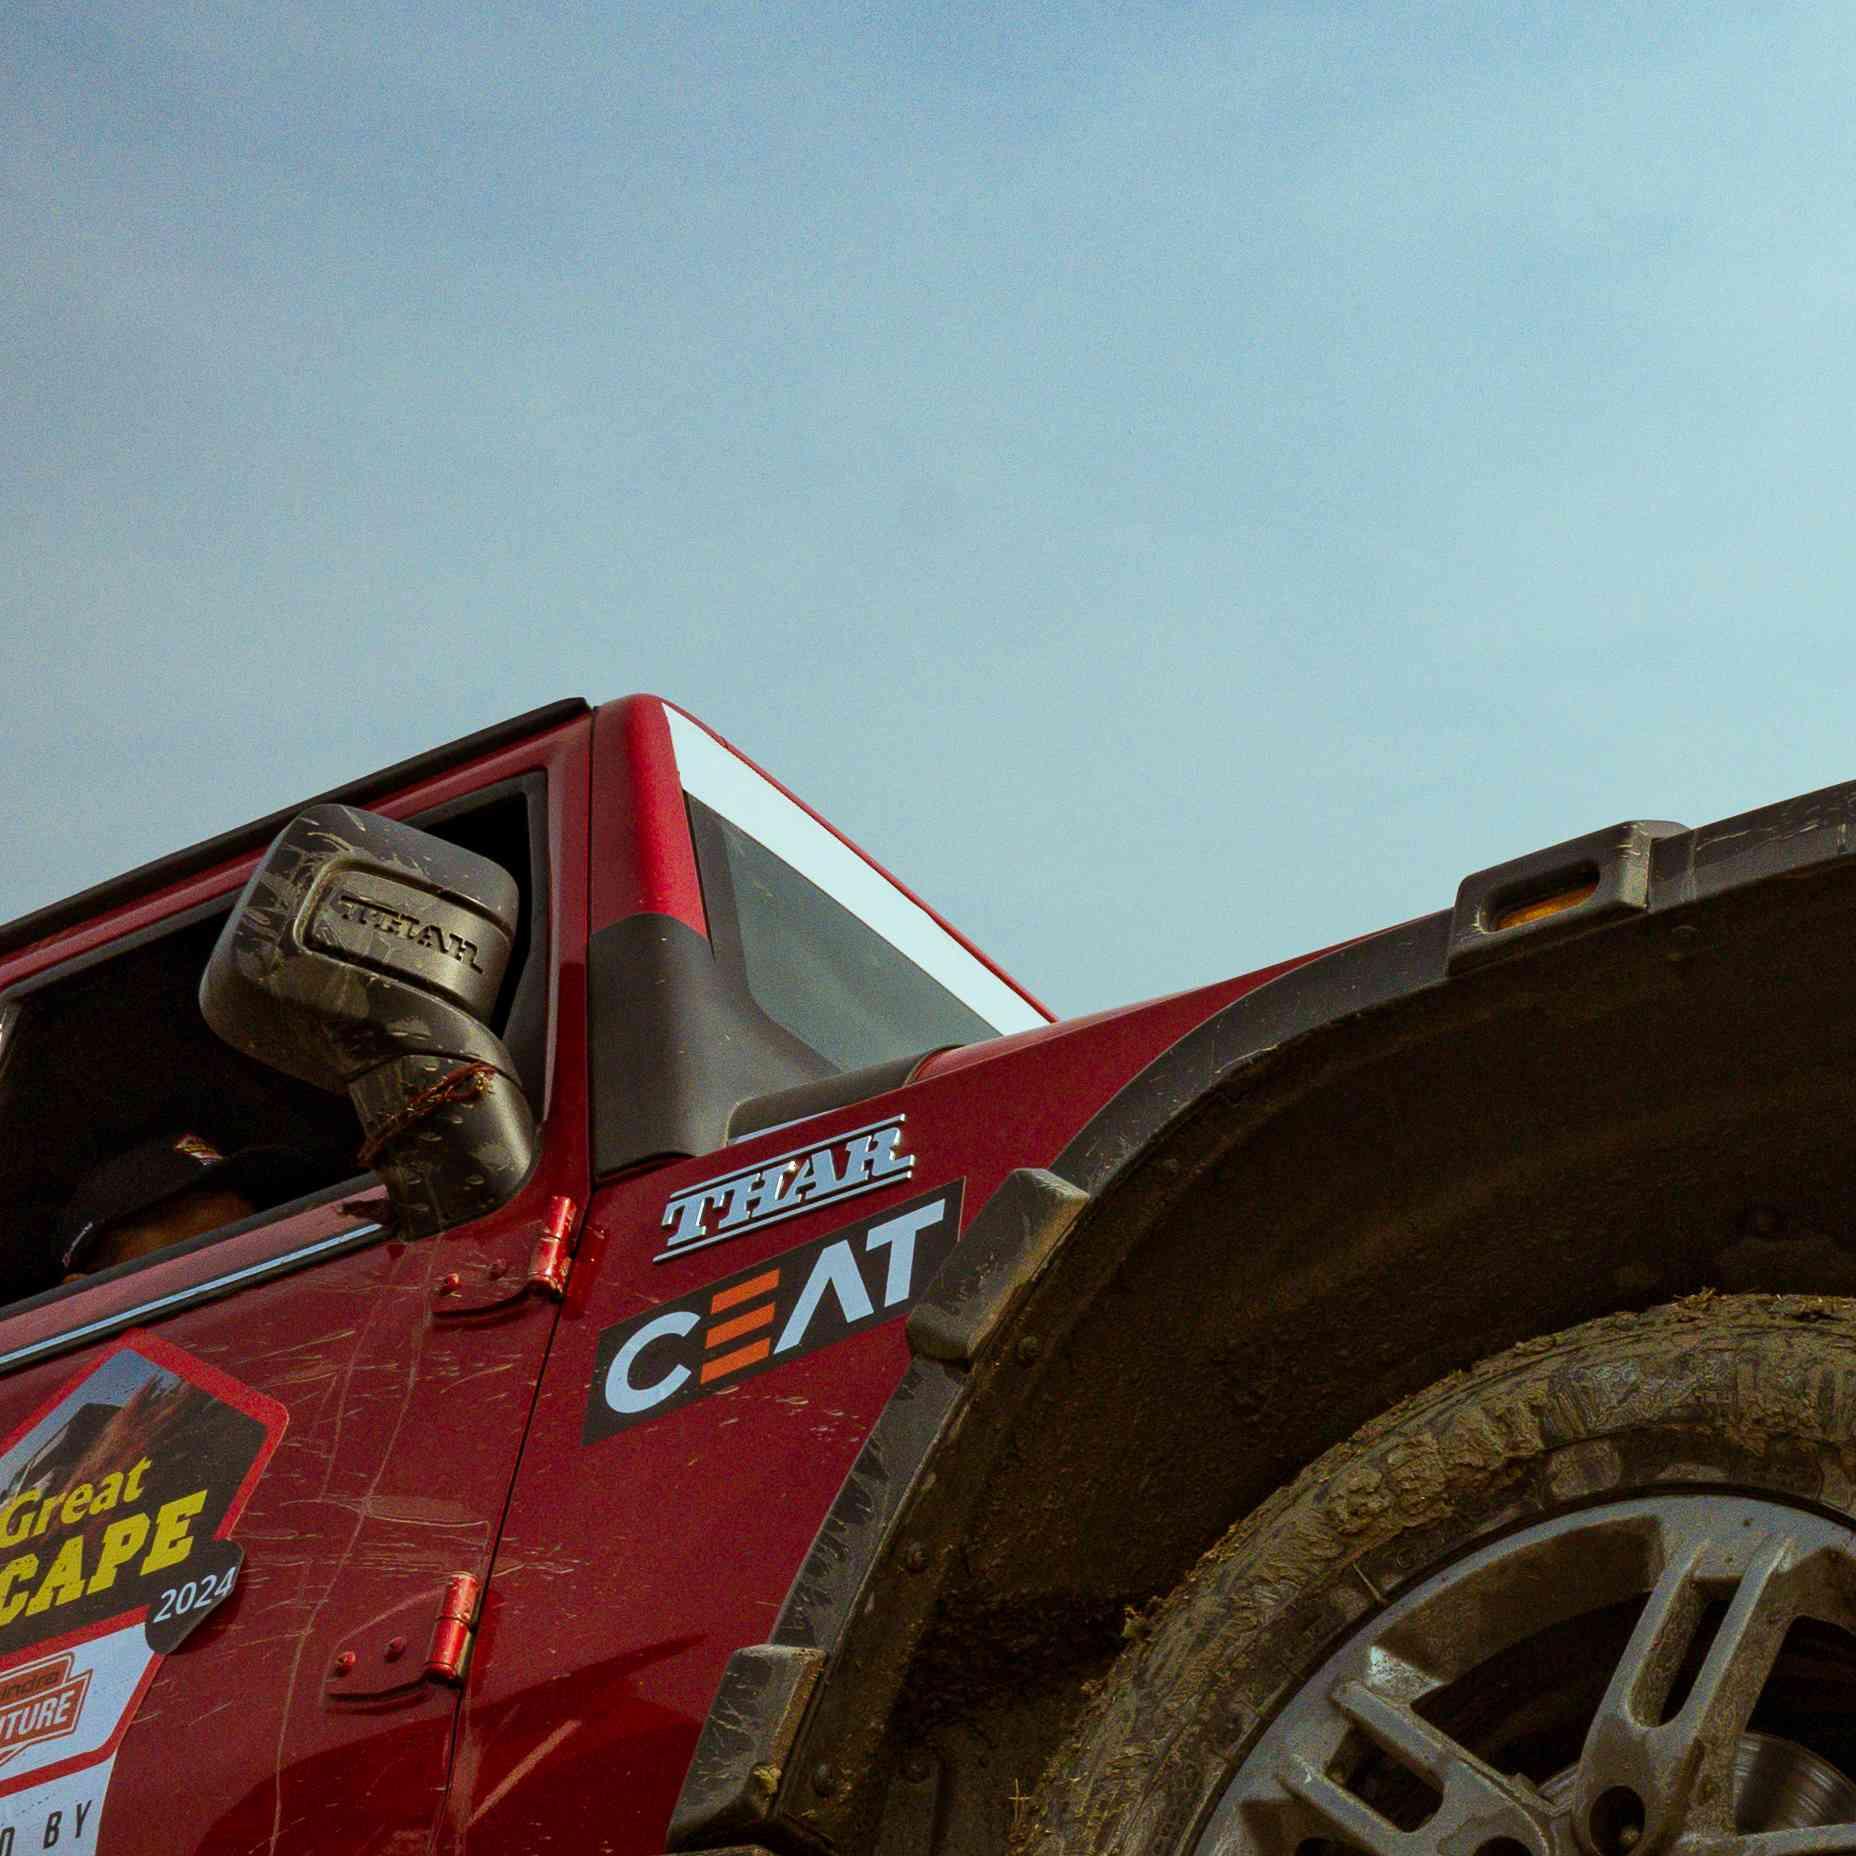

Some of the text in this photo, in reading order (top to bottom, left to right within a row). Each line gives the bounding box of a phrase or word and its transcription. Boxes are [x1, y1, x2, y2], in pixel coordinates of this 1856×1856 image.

[340, 894, 484, 975] THAR
[660, 1126, 917, 1248] THAR
[604, 1198, 946, 1414] CEAT
[0, 1456, 152, 1549] Great
[153, 1566, 237, 1624] 2024
[43, 1799, 92, 1850] BY
